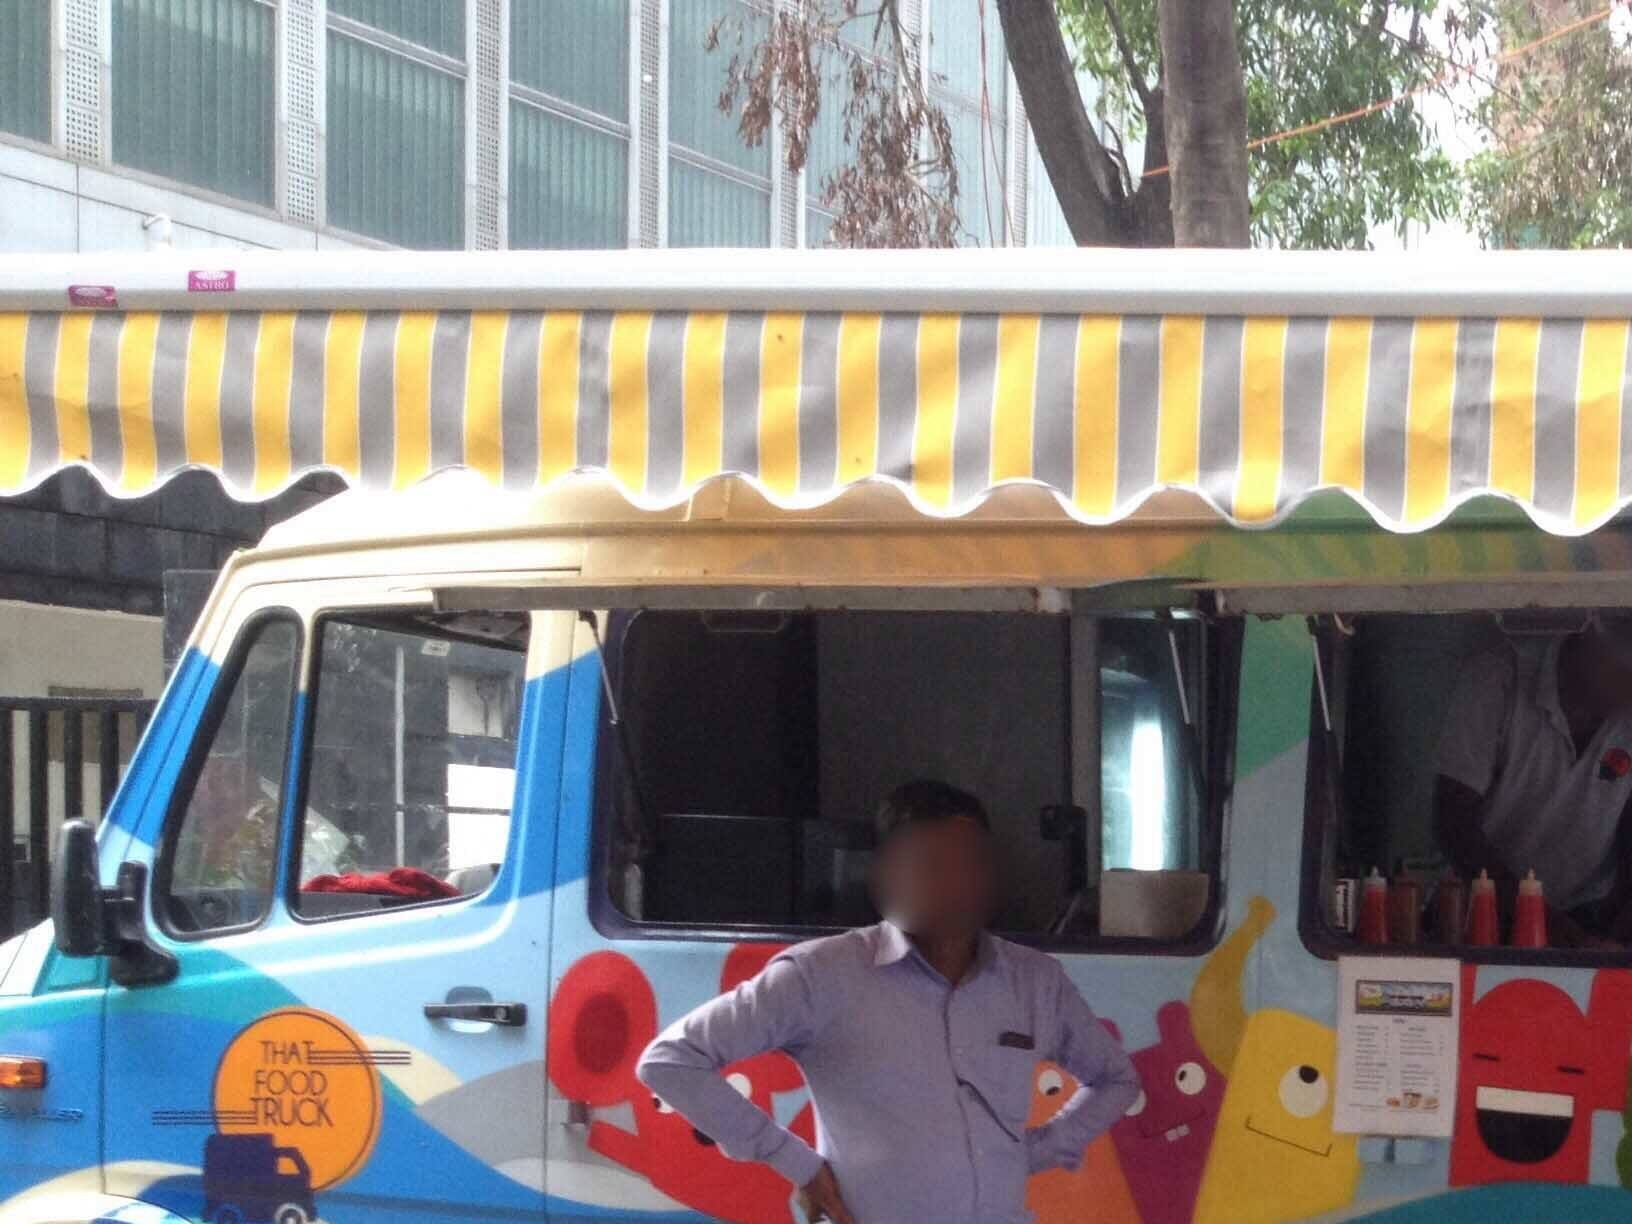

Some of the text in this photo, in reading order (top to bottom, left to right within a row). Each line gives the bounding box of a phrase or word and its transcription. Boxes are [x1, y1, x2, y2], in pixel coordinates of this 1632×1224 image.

[259, 1040, 315, 1065] THAT
[255, 1069, 328, 1096] FOOD
[250, 1097, 334, 1128] TRUCK
